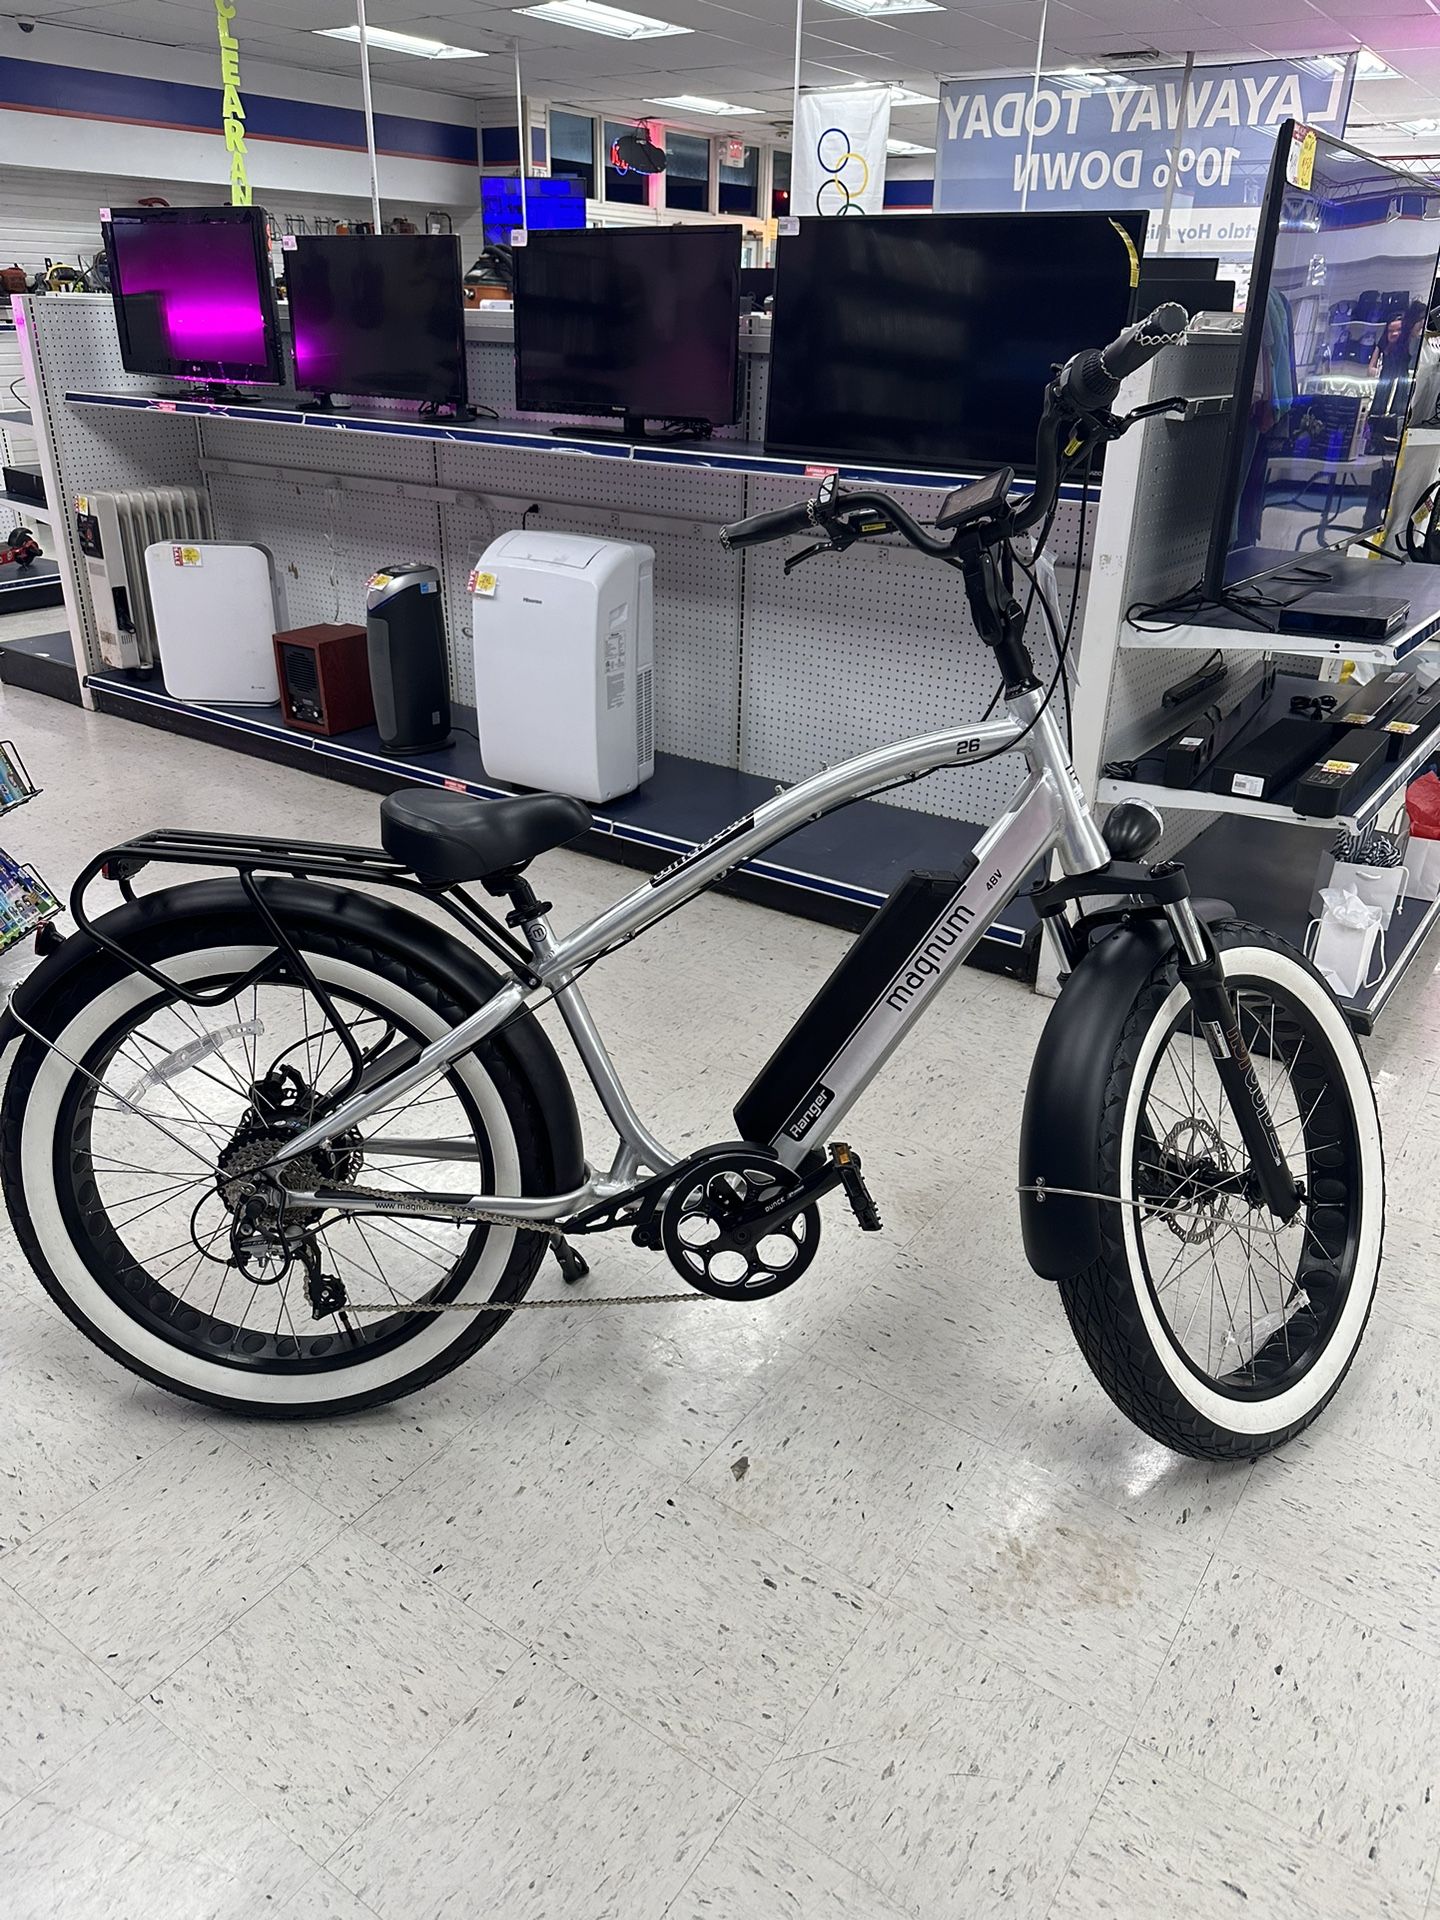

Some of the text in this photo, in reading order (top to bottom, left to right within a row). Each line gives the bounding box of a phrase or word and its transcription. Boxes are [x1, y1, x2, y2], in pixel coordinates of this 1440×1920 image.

[466, 570, 476, 592] SALE
[956, 738, 981, 755] 26
[985, 868, 1003, 891] 48V
[885, 905, 976, 1012] magnum
[789, 1089, 828, 1138] Ranger
